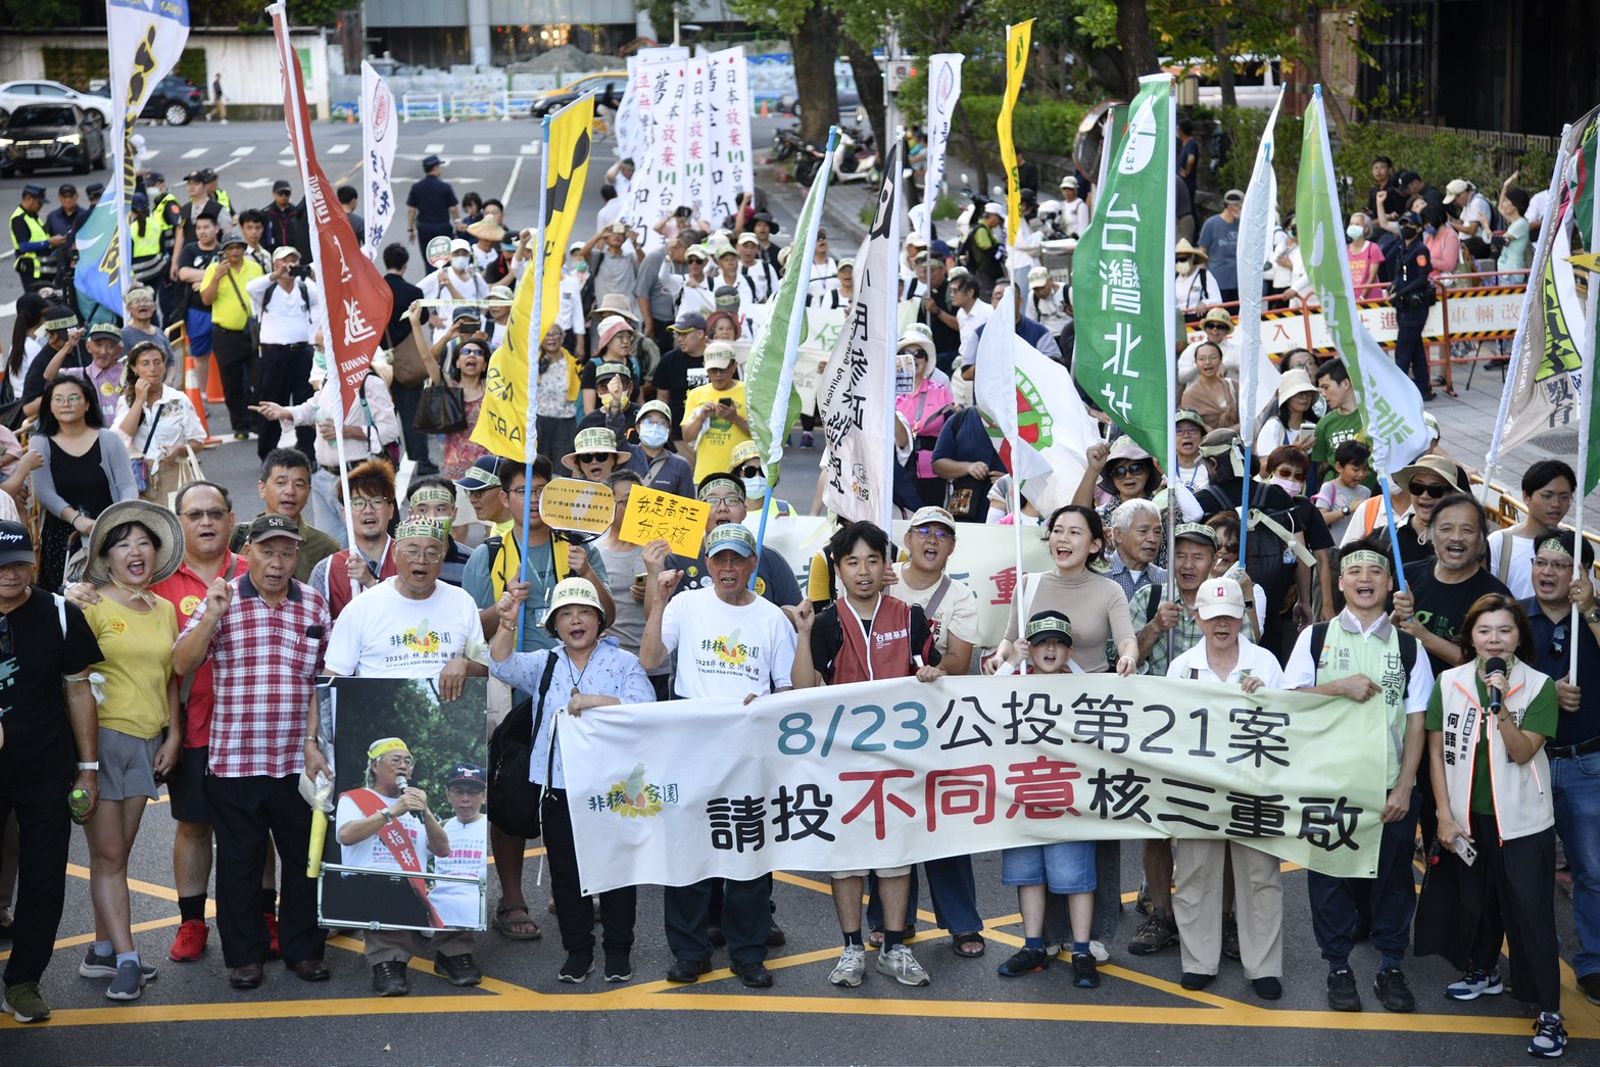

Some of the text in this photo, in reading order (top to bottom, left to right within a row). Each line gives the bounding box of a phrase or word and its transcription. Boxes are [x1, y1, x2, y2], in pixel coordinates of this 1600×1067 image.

[777, 692, 1290, 767] 8/23公投第21案
[588, 783, 679, 812] 非核家園
[705, 755, 1363, 853] 請投不同意核三重啟
